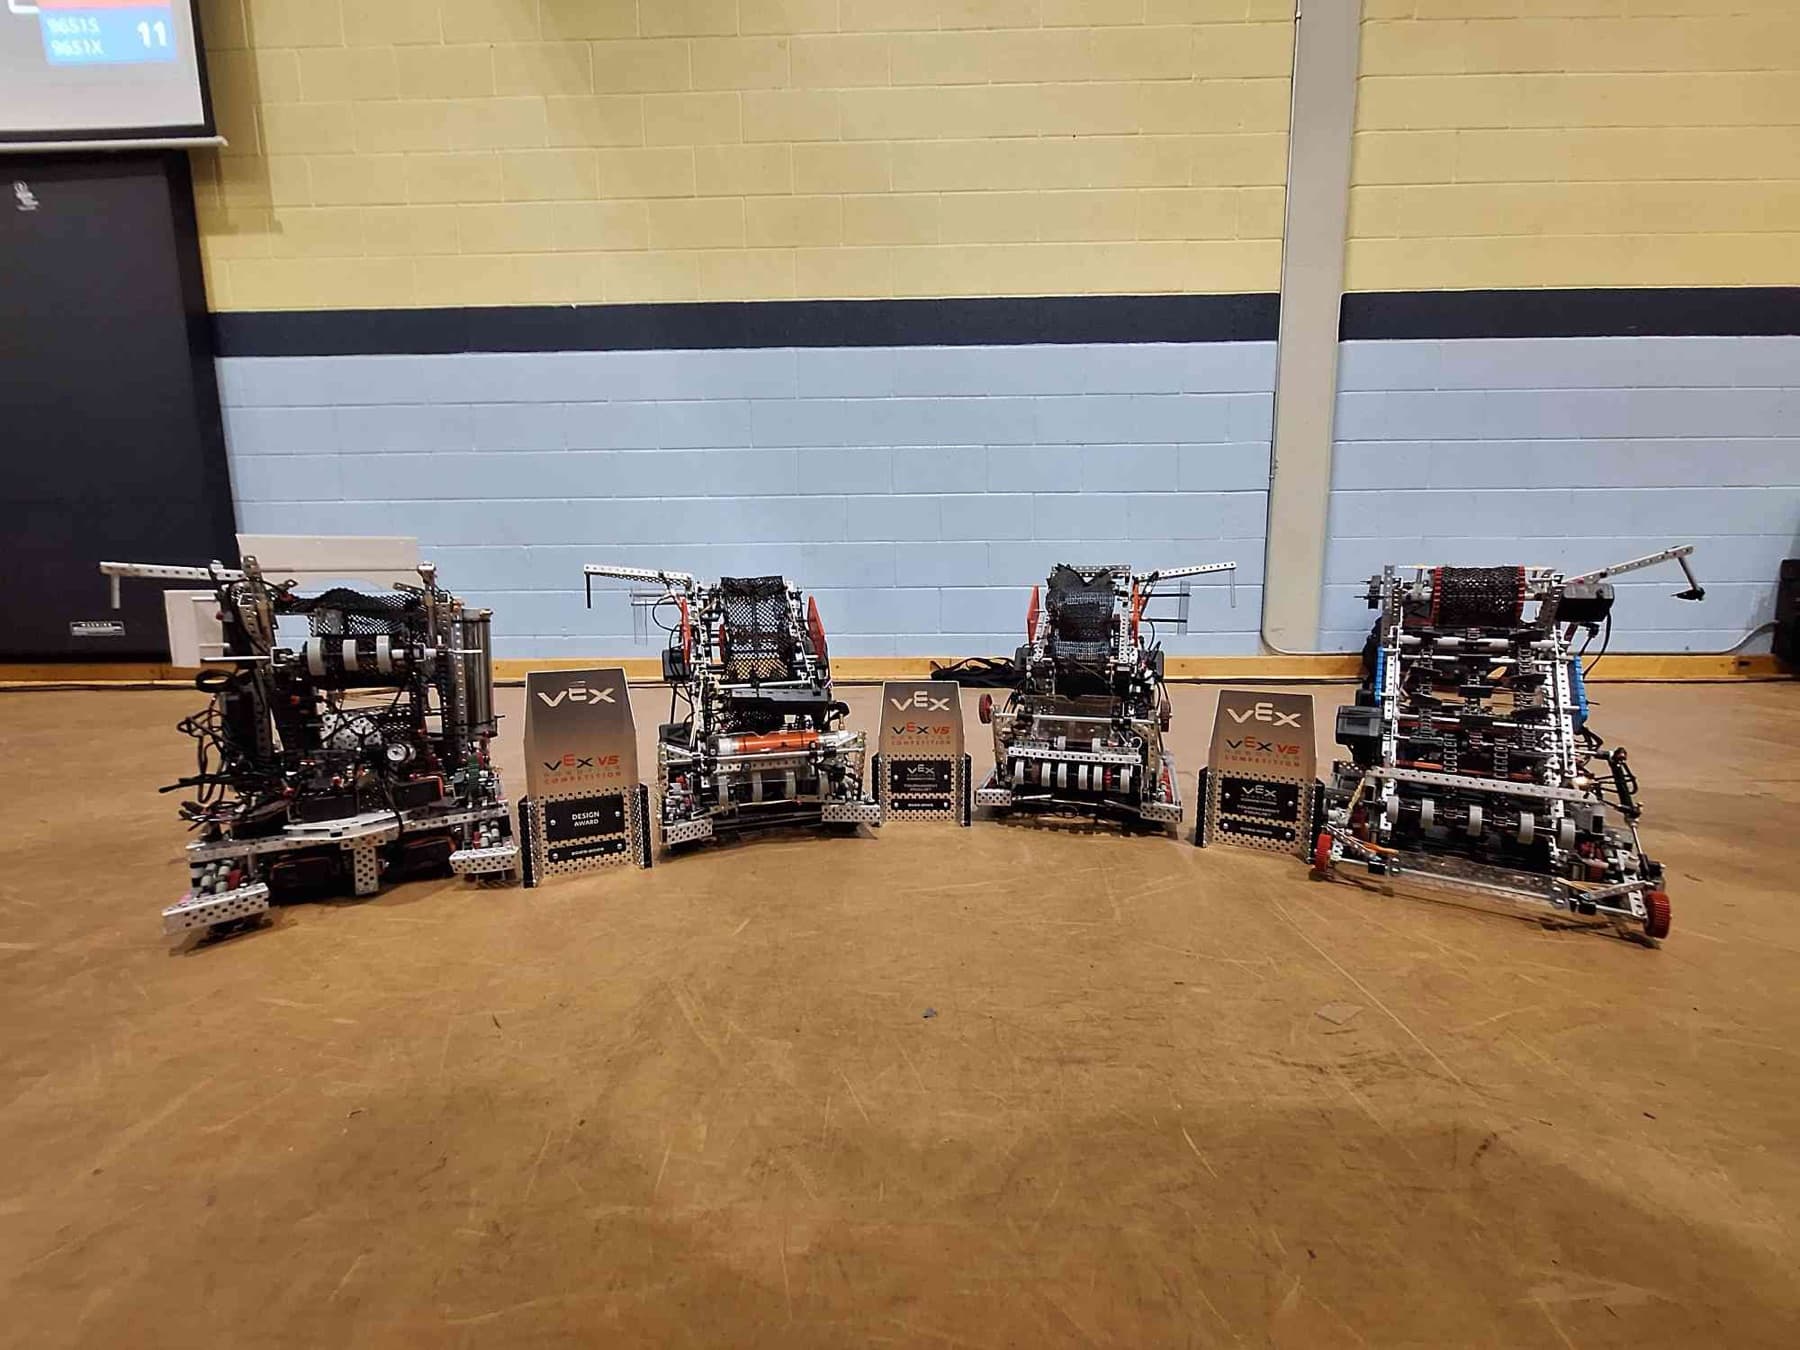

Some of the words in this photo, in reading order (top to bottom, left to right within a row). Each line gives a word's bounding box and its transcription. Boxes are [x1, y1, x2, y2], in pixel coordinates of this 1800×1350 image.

[137, 20, 167, 48] 11
[537, 680, 616, 707] VEX
[891, 690, 950, 711] VEX
[1227, 702, 1302, 728] VEX
[891, 721, 929, 735] VEX
[1226, 736, 1273, 752] VEX
[544, 754, 593, 771] VEX
[571, 811, 600, 820] DESIGN
[573, 818, 599, 827] AWARD
